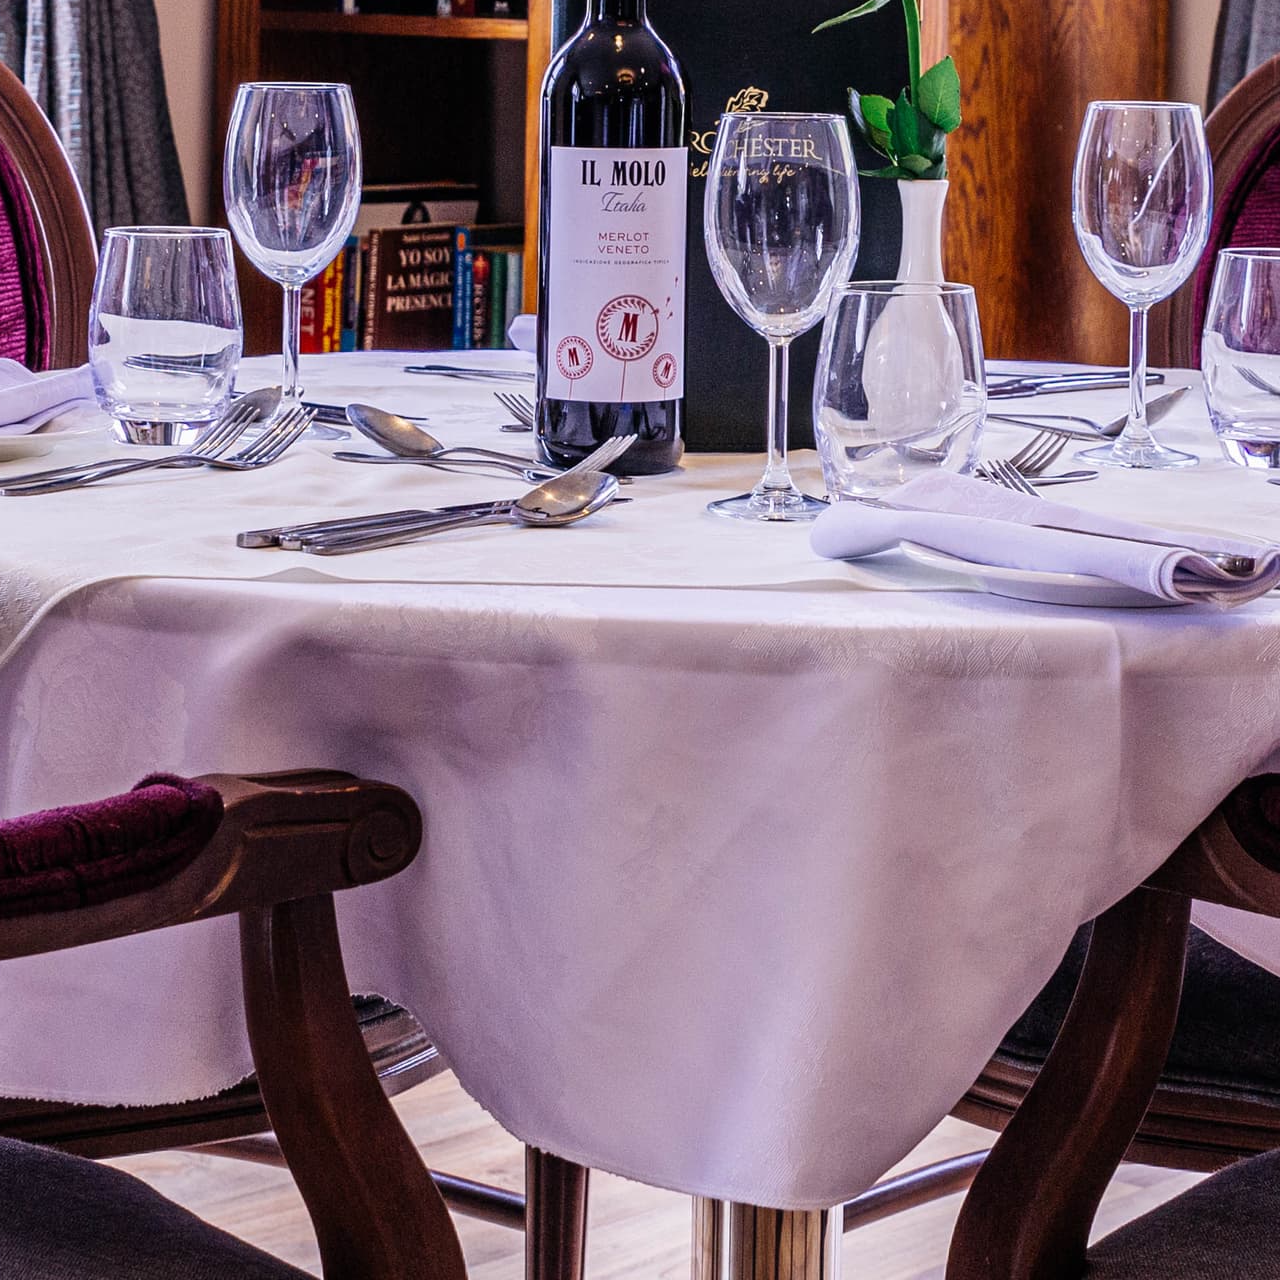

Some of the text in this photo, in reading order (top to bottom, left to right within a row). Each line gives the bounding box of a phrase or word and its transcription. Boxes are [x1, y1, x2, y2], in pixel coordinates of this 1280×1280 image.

[581, 160, 666, 187] IL MOLO
[773, 163, 797, 184] life
[601, 191, 647, 213] Italia
[598, 232, 649, 242] MERLOT
[399, 246, 451, 267] YO SOY
[598, 245, 650, 255] VENETO
[387, 268, 451, 291] LA MÁGIC
[386, 293, 452, 312] PRESENCI
[617, 312, 640, 343] M
[568, 347, 580, 368] M
[661, 361, 671, 379] M
